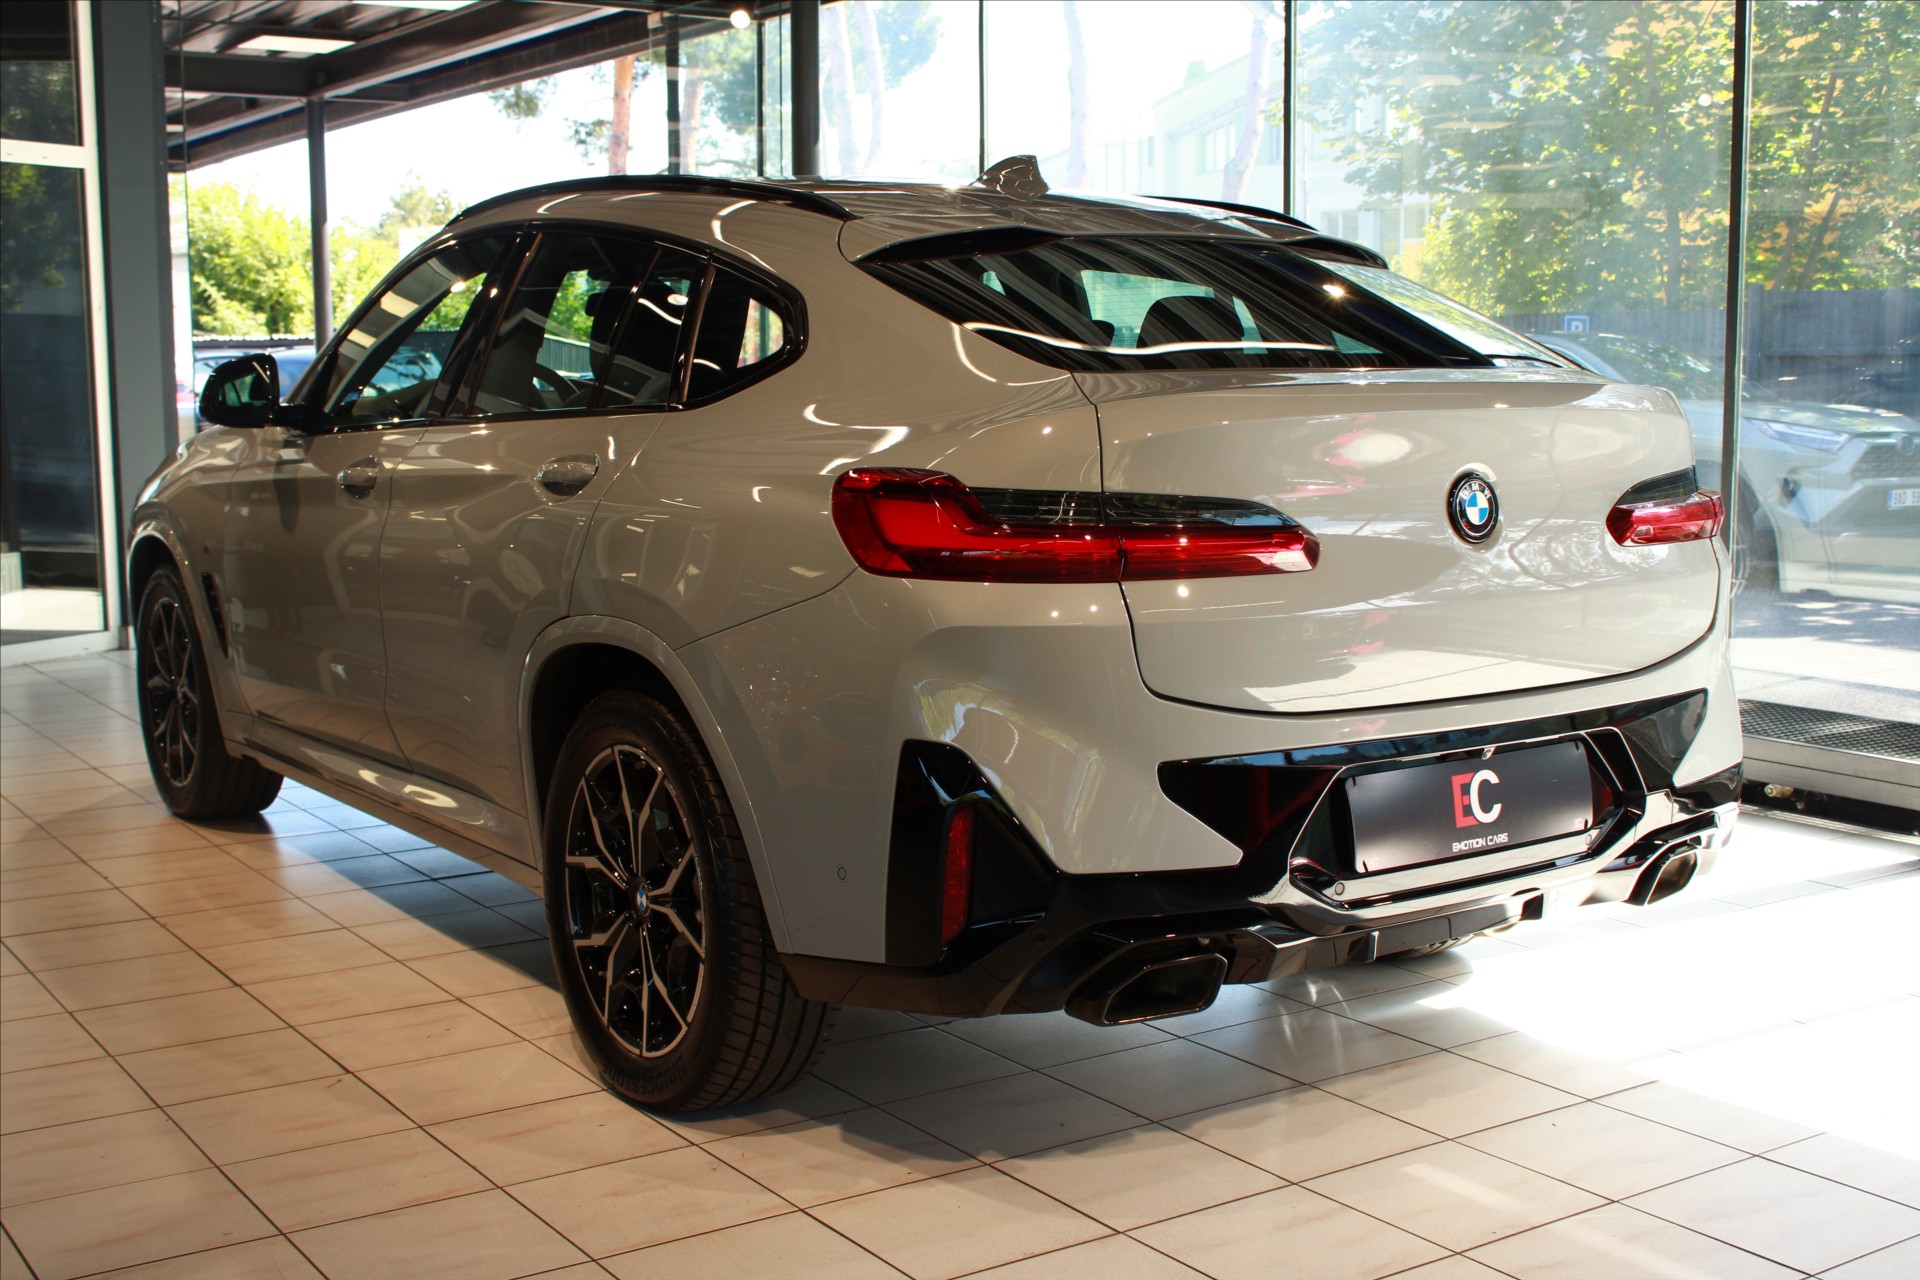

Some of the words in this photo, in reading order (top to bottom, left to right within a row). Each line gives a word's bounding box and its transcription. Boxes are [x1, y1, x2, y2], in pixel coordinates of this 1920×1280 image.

[1460, 482, 1492, 500] BMW
[1451, 769, 1502, 829] EC
[1452, 837, 1486, 852] EMOTION
[1487, 832, 1509, 845] CARS
